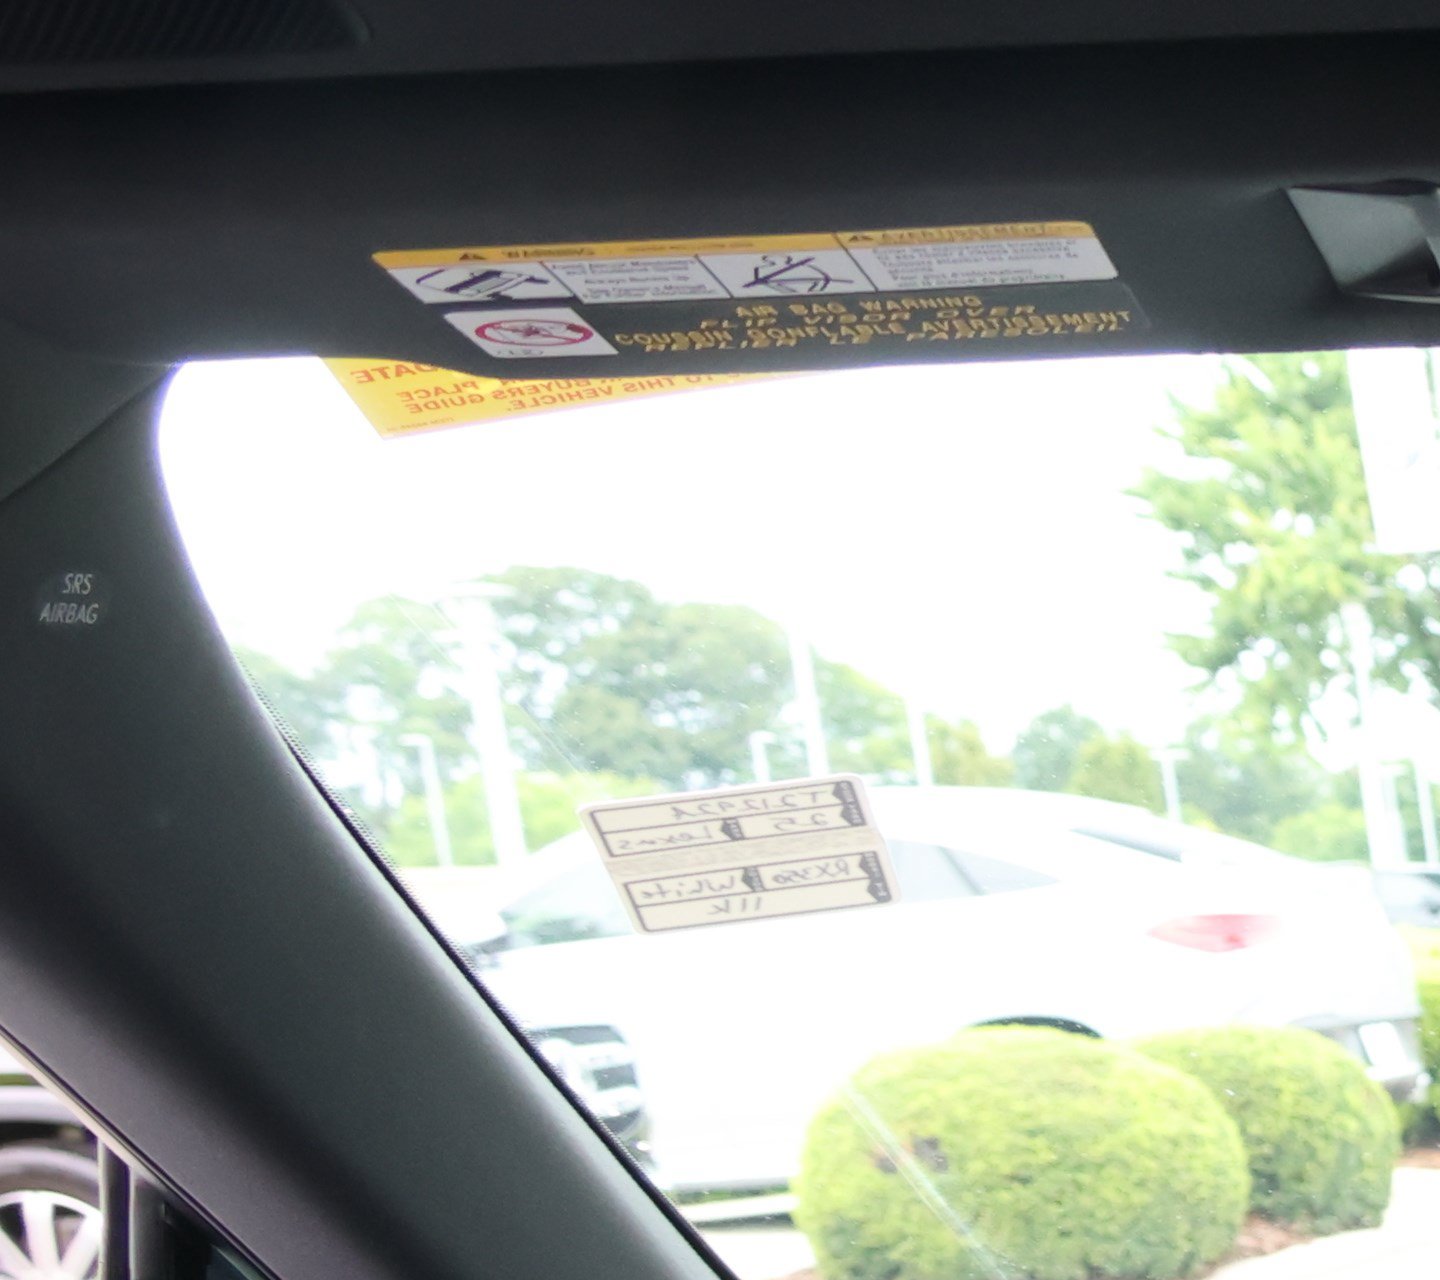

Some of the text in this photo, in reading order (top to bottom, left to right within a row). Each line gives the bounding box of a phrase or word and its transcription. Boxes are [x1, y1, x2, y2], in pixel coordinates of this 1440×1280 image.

[860, 295, 983, 312] WARNING
[62, 573, 95, 595] SRS
[39, 602, 100, 624] AIRBAG
